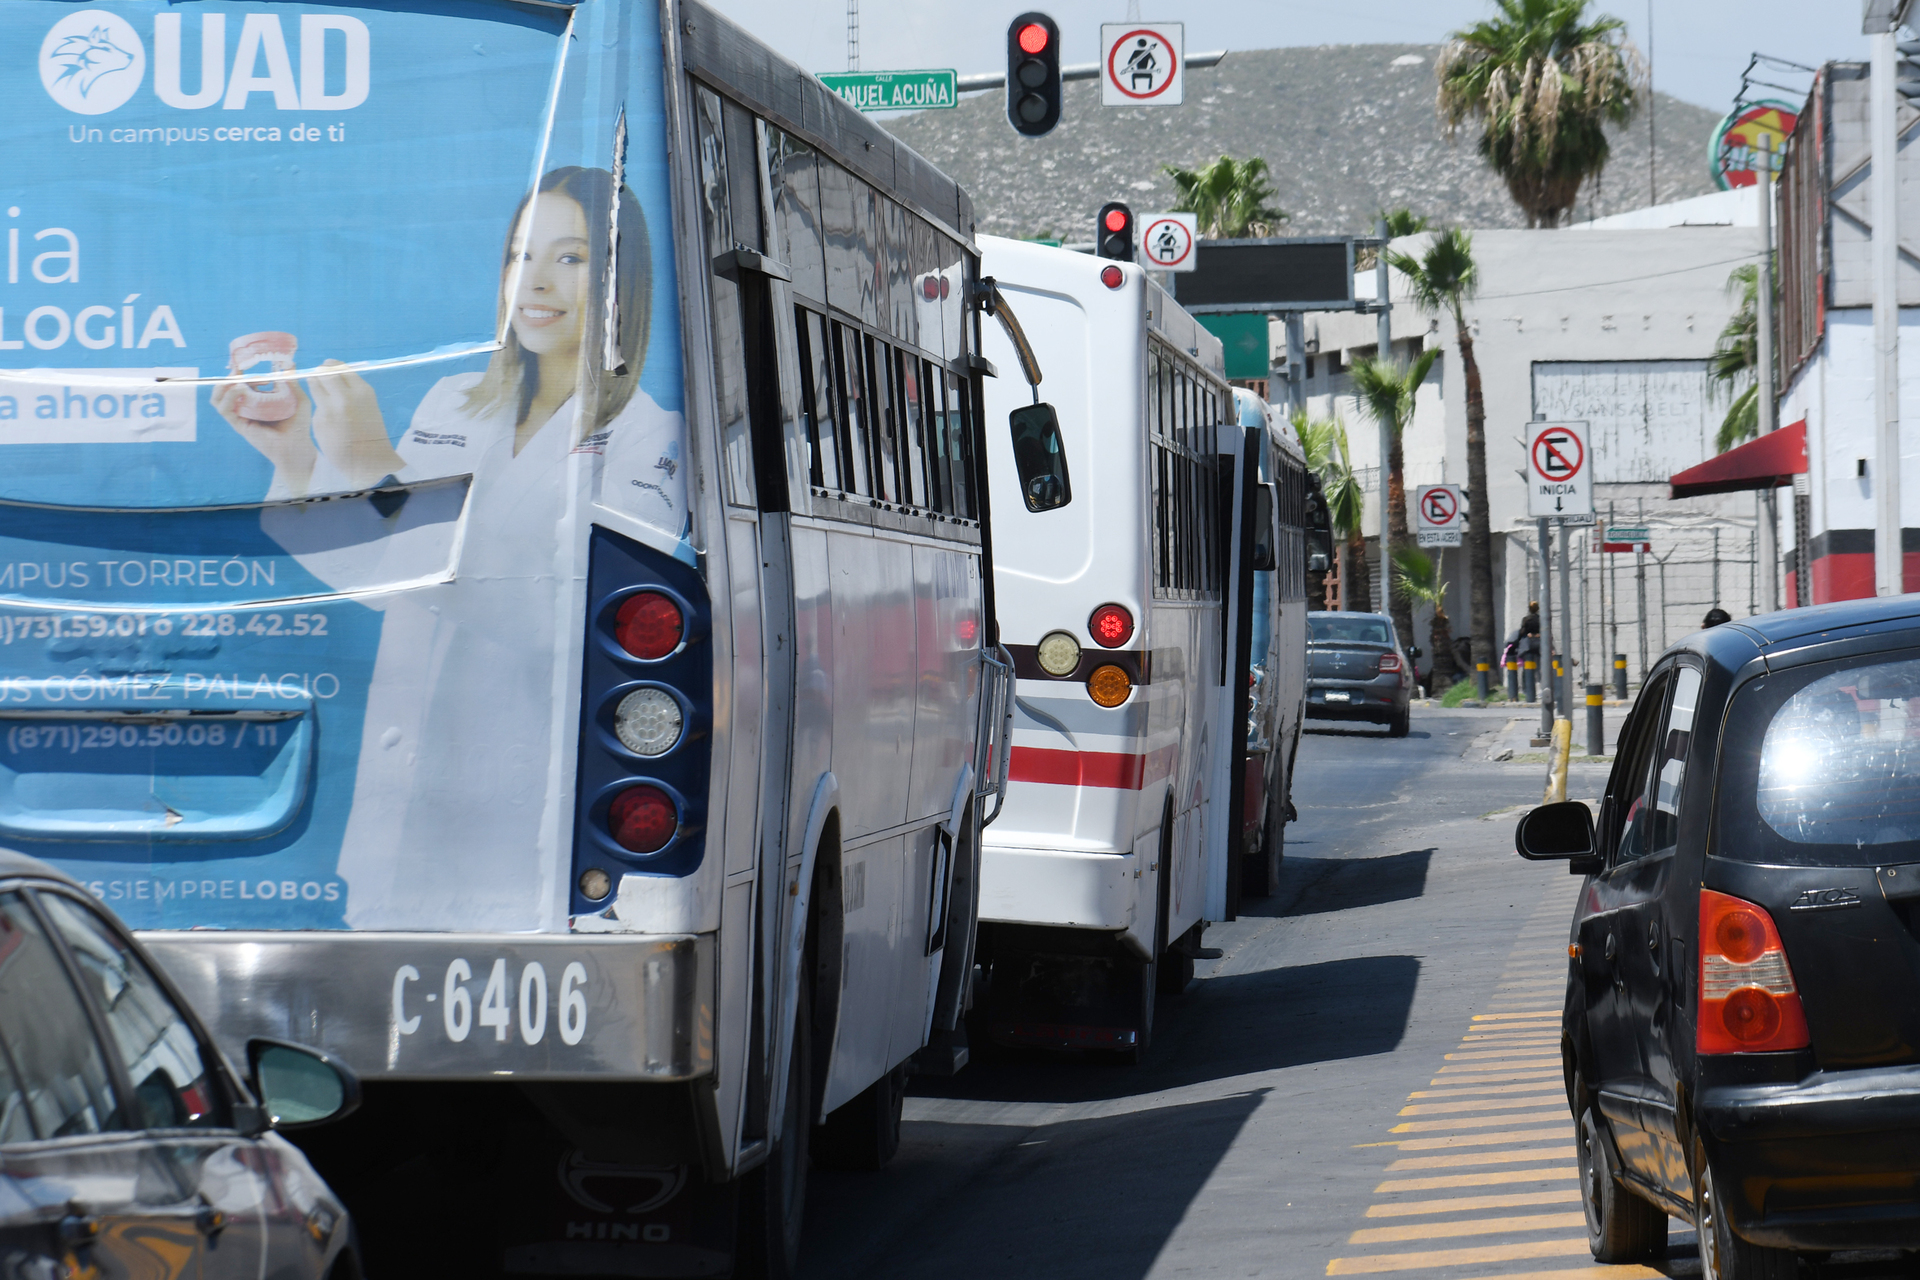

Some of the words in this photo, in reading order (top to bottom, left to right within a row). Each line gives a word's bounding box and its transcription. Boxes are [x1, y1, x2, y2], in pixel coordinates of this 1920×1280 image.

[154, 12, 370, 110] UAD
[892, 78, 949, 105] ACUÑA
[69, 125, 103, 143] Un
[109, 126, 210, 146] campus
[214, 125, 282, 143] cerca
[289, 123, 321, 142] de
[328, 122, 345, 142] ti
[6, 205, 80, 284] ia
[0, 293, 188, 351] LOGÍA
[35, 385, 167, 420] ahora
[1539, 484, 1577, 495] INICIA
[99, 554, 276, 588] TORREÓN
[181, 613, 329, 637] 228.42.52
[41, 668, 173, 702] GÓMEZ
[184, 672, 341, 700] PALACIO
[255, 724, 278, 746] 11
[1791, 886, 1860, 905] ATOS
[391, 958, 588, 1046] C-6406
[1014, 1025, 1114, 1042] Laura
[565, 1220, 670, 1242] HINO
